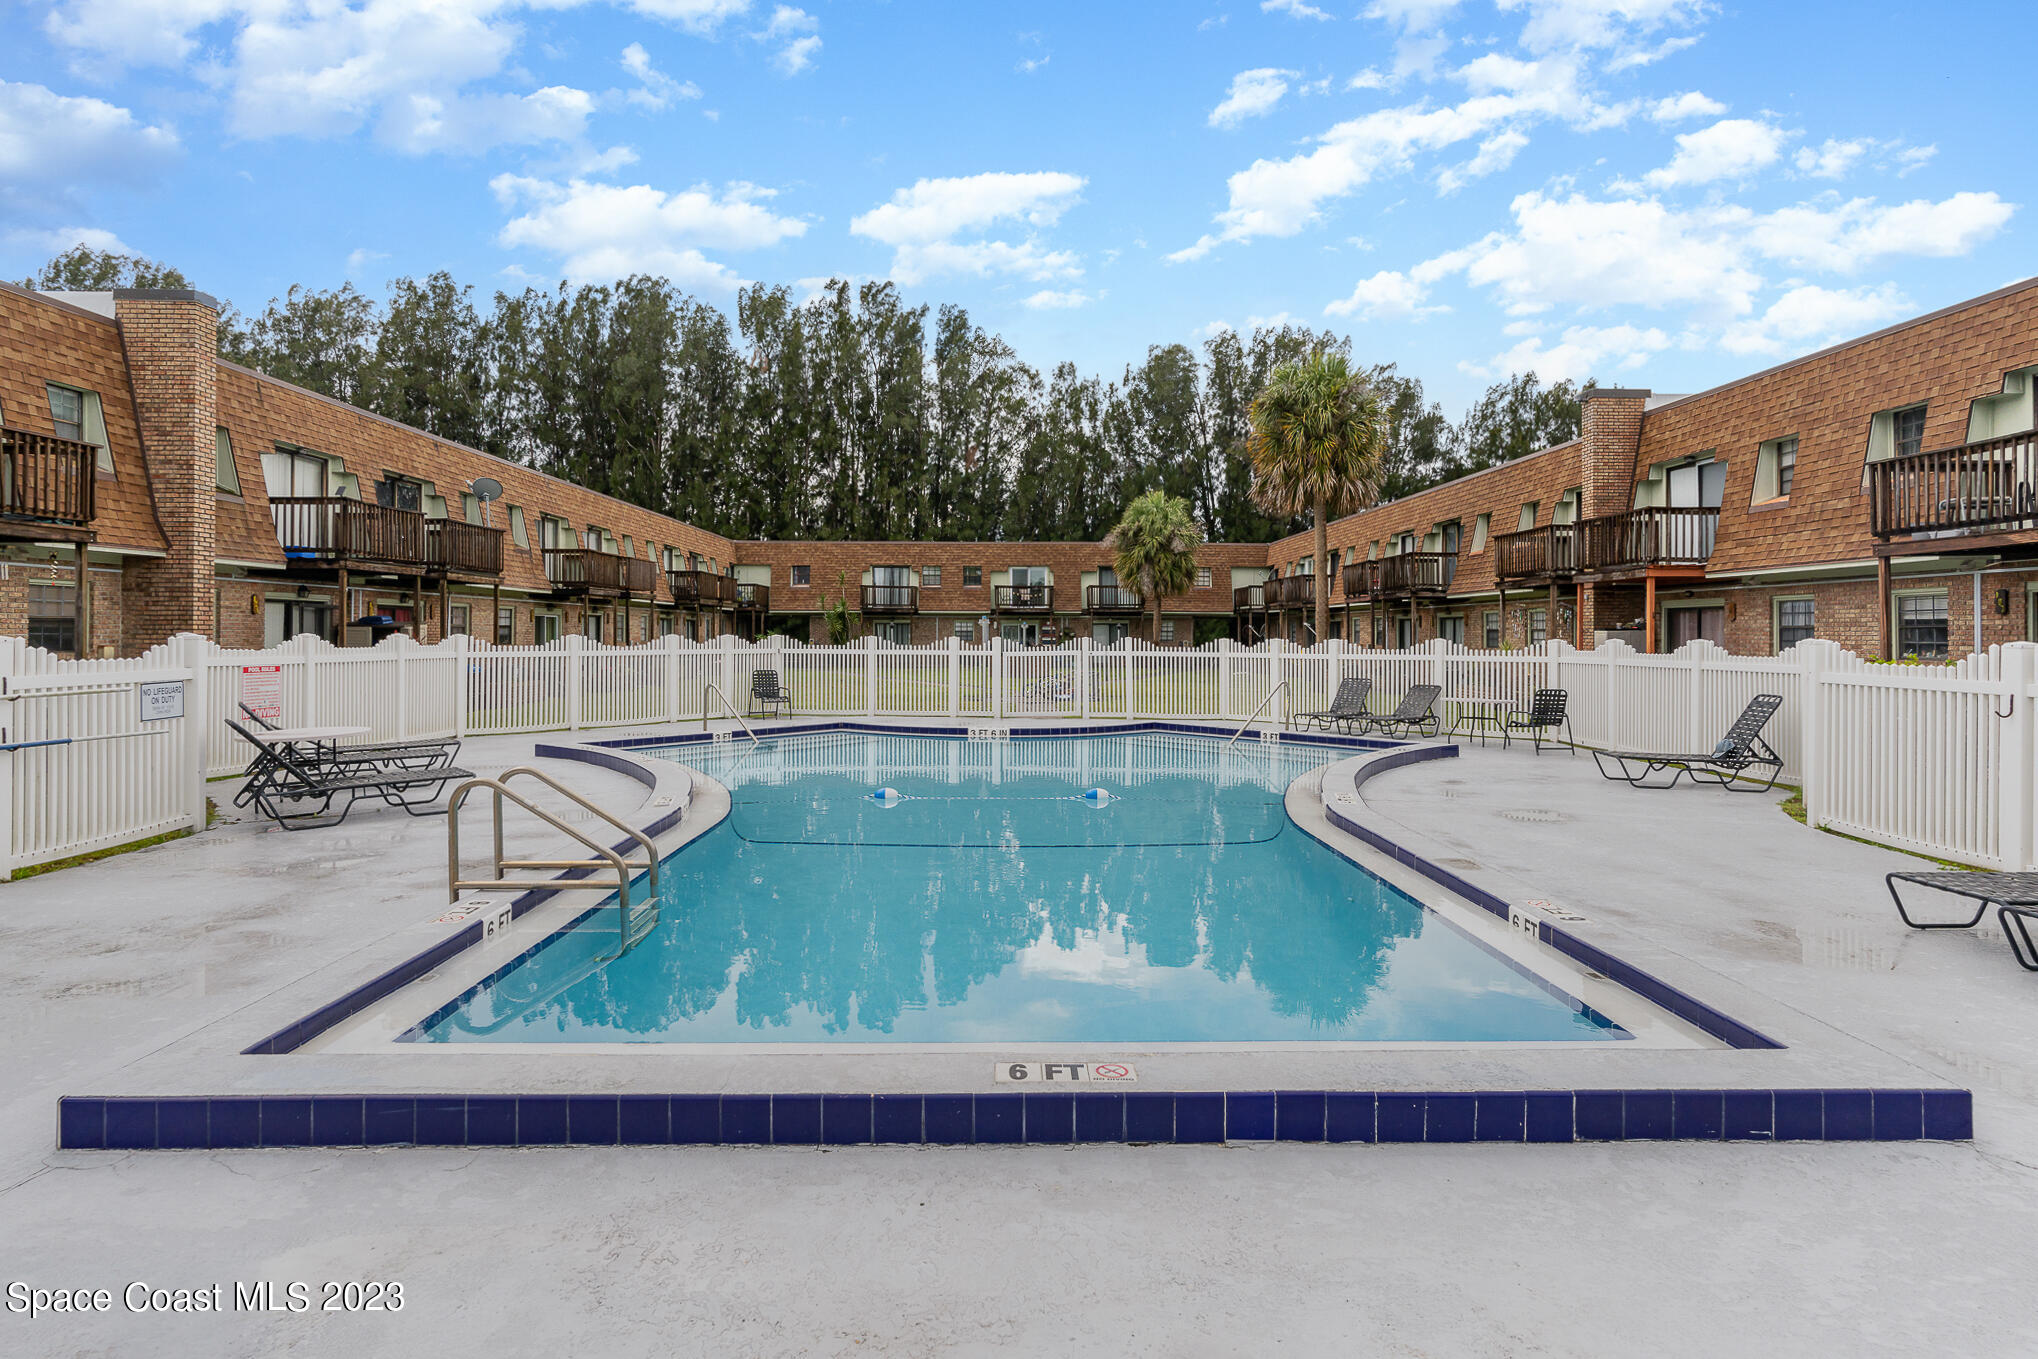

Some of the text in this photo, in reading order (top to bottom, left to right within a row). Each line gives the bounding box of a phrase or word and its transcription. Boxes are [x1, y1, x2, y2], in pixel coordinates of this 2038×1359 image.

[143, 685, 182, 696] NO LIFEGUARD
[151, 695, 175, 705] ON DUTY
[723, 732, 732, 740] FT
[1270, 732, 1279, 740] FT
[487, 908, 511, 936] 6 FT
[1513, 914, 1538, 937] 6 FT
[1008, 1063, 1084, 1080] 6 FT
